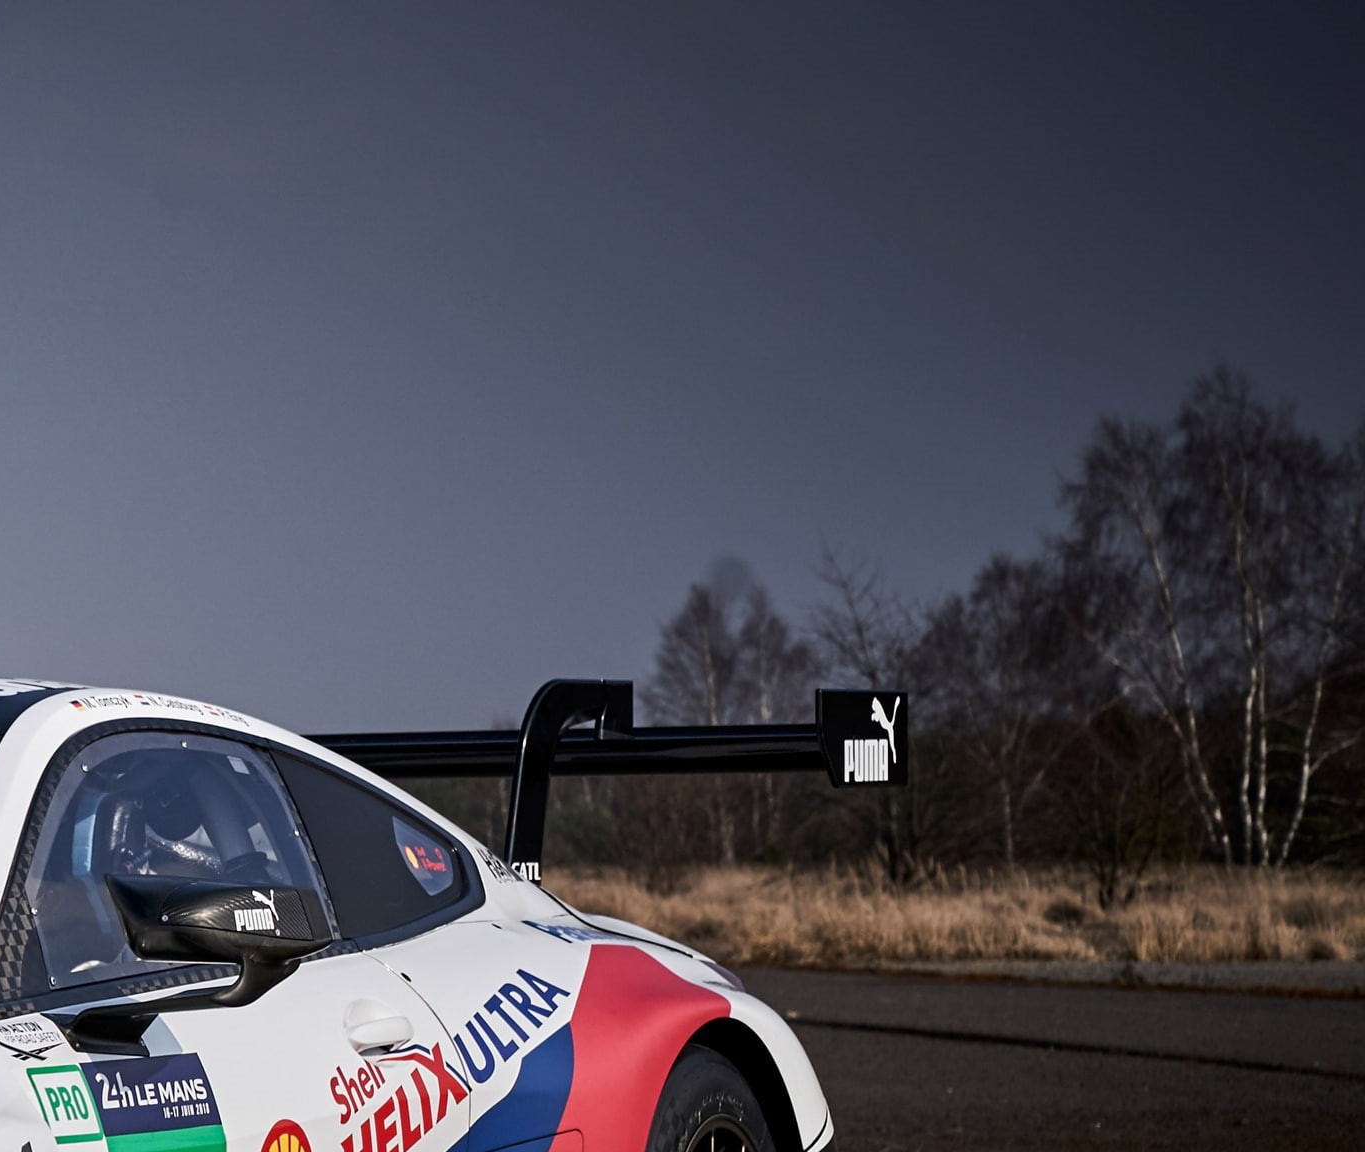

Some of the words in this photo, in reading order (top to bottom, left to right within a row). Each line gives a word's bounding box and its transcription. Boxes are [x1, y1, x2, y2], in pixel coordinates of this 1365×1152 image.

[844, 739, 888, 782] PUMA
[511, 861, 541, 881] CATL
[234, 908, 275, 932] PUMA
[7, 1021, 43, 1033] ACTION
[453, 968, 570, 1084] ULTRA
[44, 1085, 89, 1121] PRO
[95, 1072, 135, 1109] 24h
[135, 1083, 158, 1106] LE
[157, 1079, 207, 1104] MANS
[330, 1058, 386, 1125] Shell
